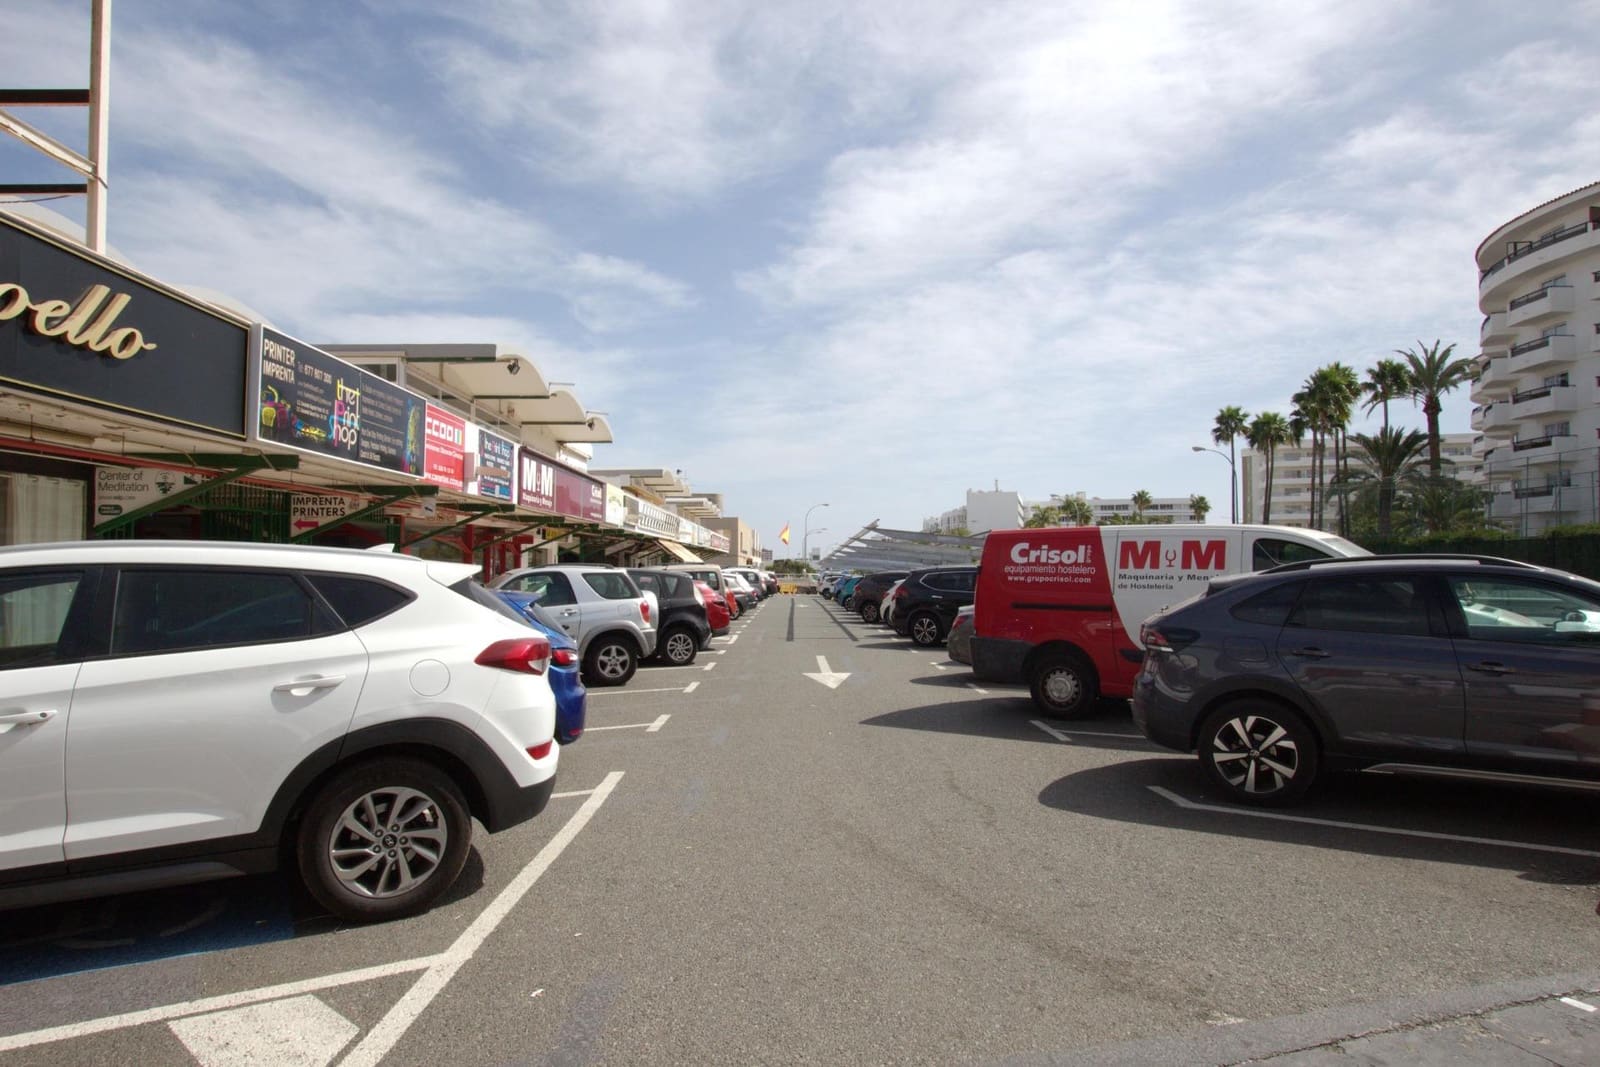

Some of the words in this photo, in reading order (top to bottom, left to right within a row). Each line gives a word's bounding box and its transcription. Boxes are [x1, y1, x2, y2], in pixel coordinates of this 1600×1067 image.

[264, 338, 296, 368] PRINTER
[263, 359, 296, 384] IMPRENTA
[426, 417, 453, 442] CCOO
[98, 470, 127, 481] Center
[133, 470, 143, 481] of
[98, 481, 149, 492] Meditation
[293, 497, 345, 506] IMPRENTA
[293, 507, 345, 517] PRINTERS
[1010, 542, 1085, 564] Crisol
[1004, 565, 1055, 574] equipamiento
[1058, 564, 1096, 574] hostelero
[1008, 575, 1092, 583] www.grupocrisol.com
[1118, 574, 1174, 582] Maquinaria
